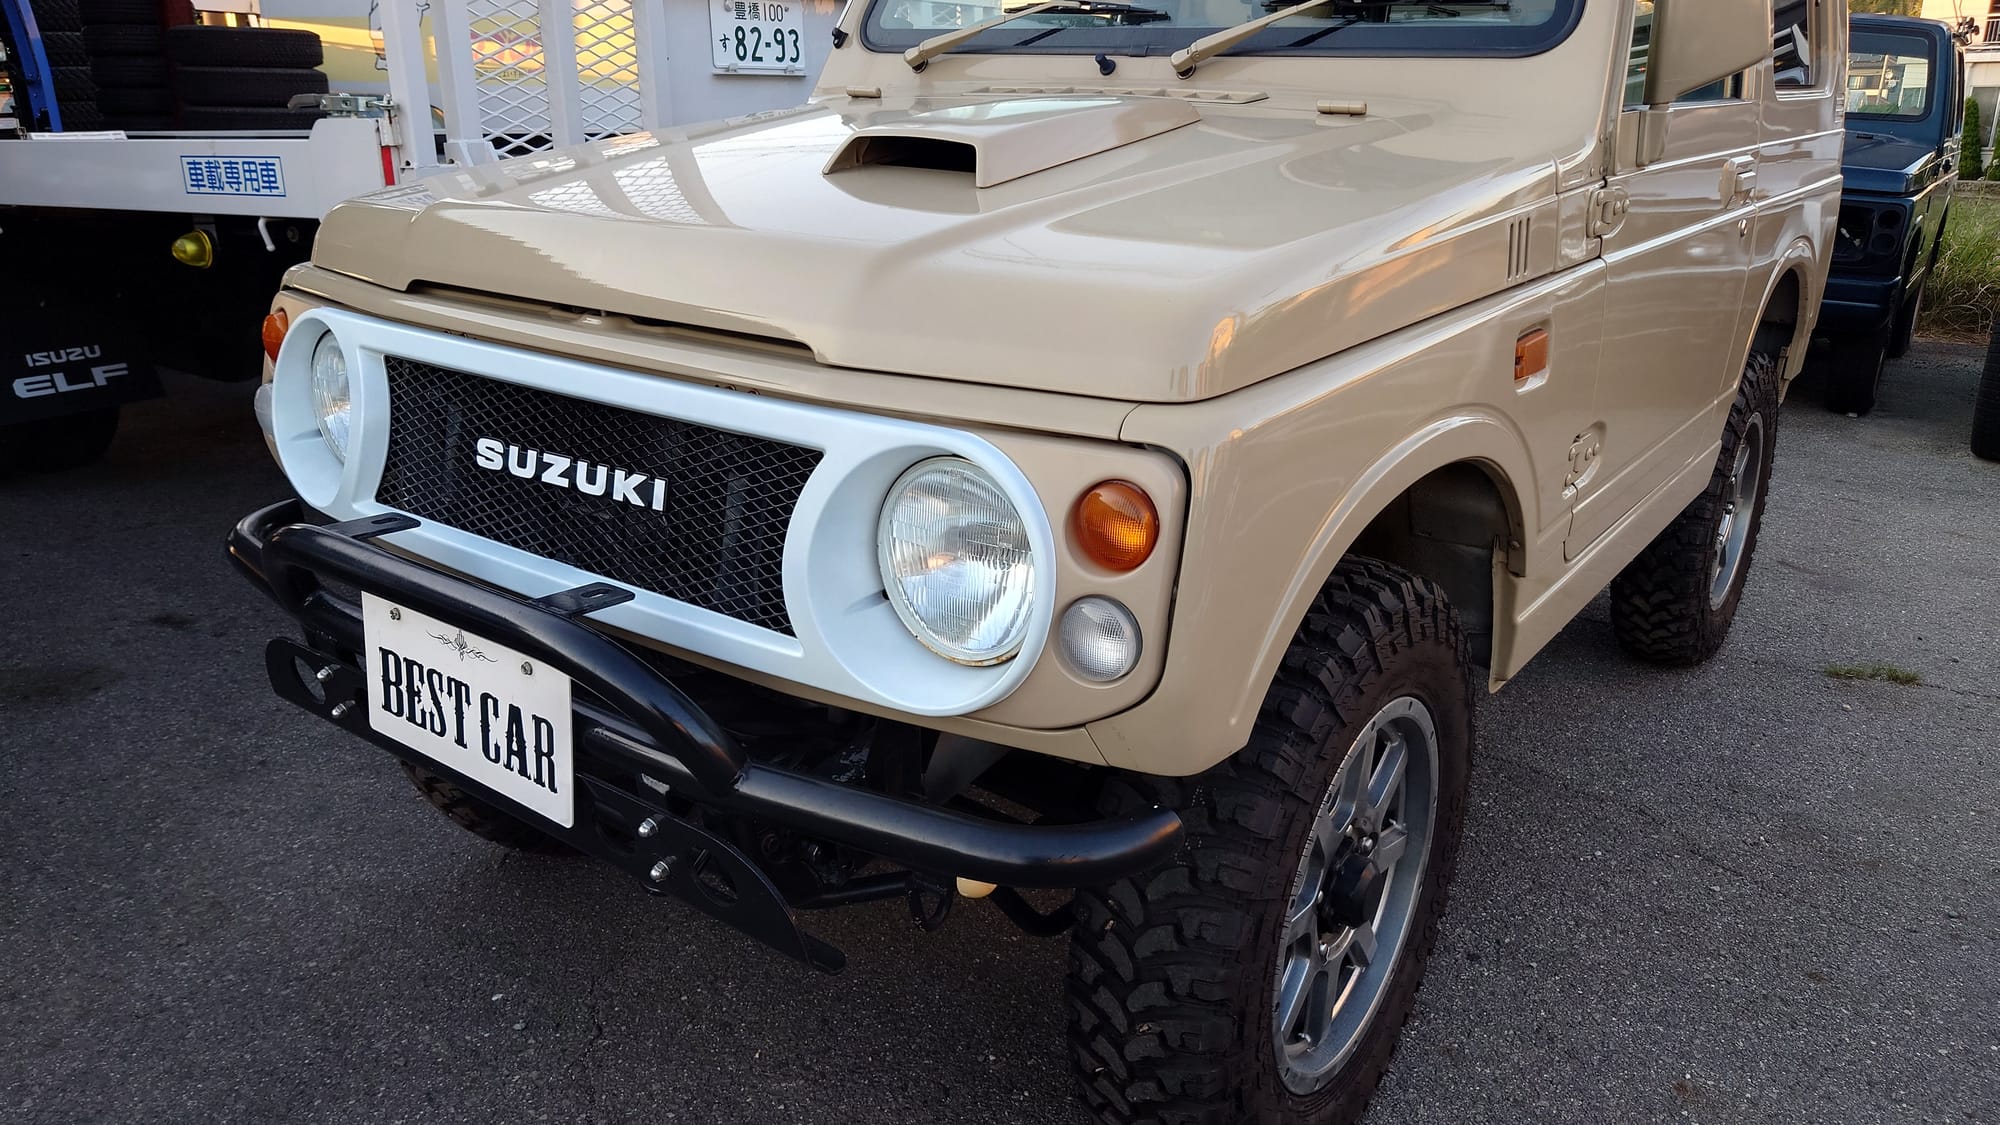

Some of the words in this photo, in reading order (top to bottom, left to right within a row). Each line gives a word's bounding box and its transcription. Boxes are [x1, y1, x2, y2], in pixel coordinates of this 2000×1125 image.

[734, 25, 800, 63] 82-93
[186, 159, 280, 193] 車載専用車
[25, 344, 101, 367] ISUZU
[12, 363, 129, 399] ELF
[476, 437, 667, 512] SUZUKI
[378, 646, 472, 749] BEST
[479, 692, 558, 794] CAR
